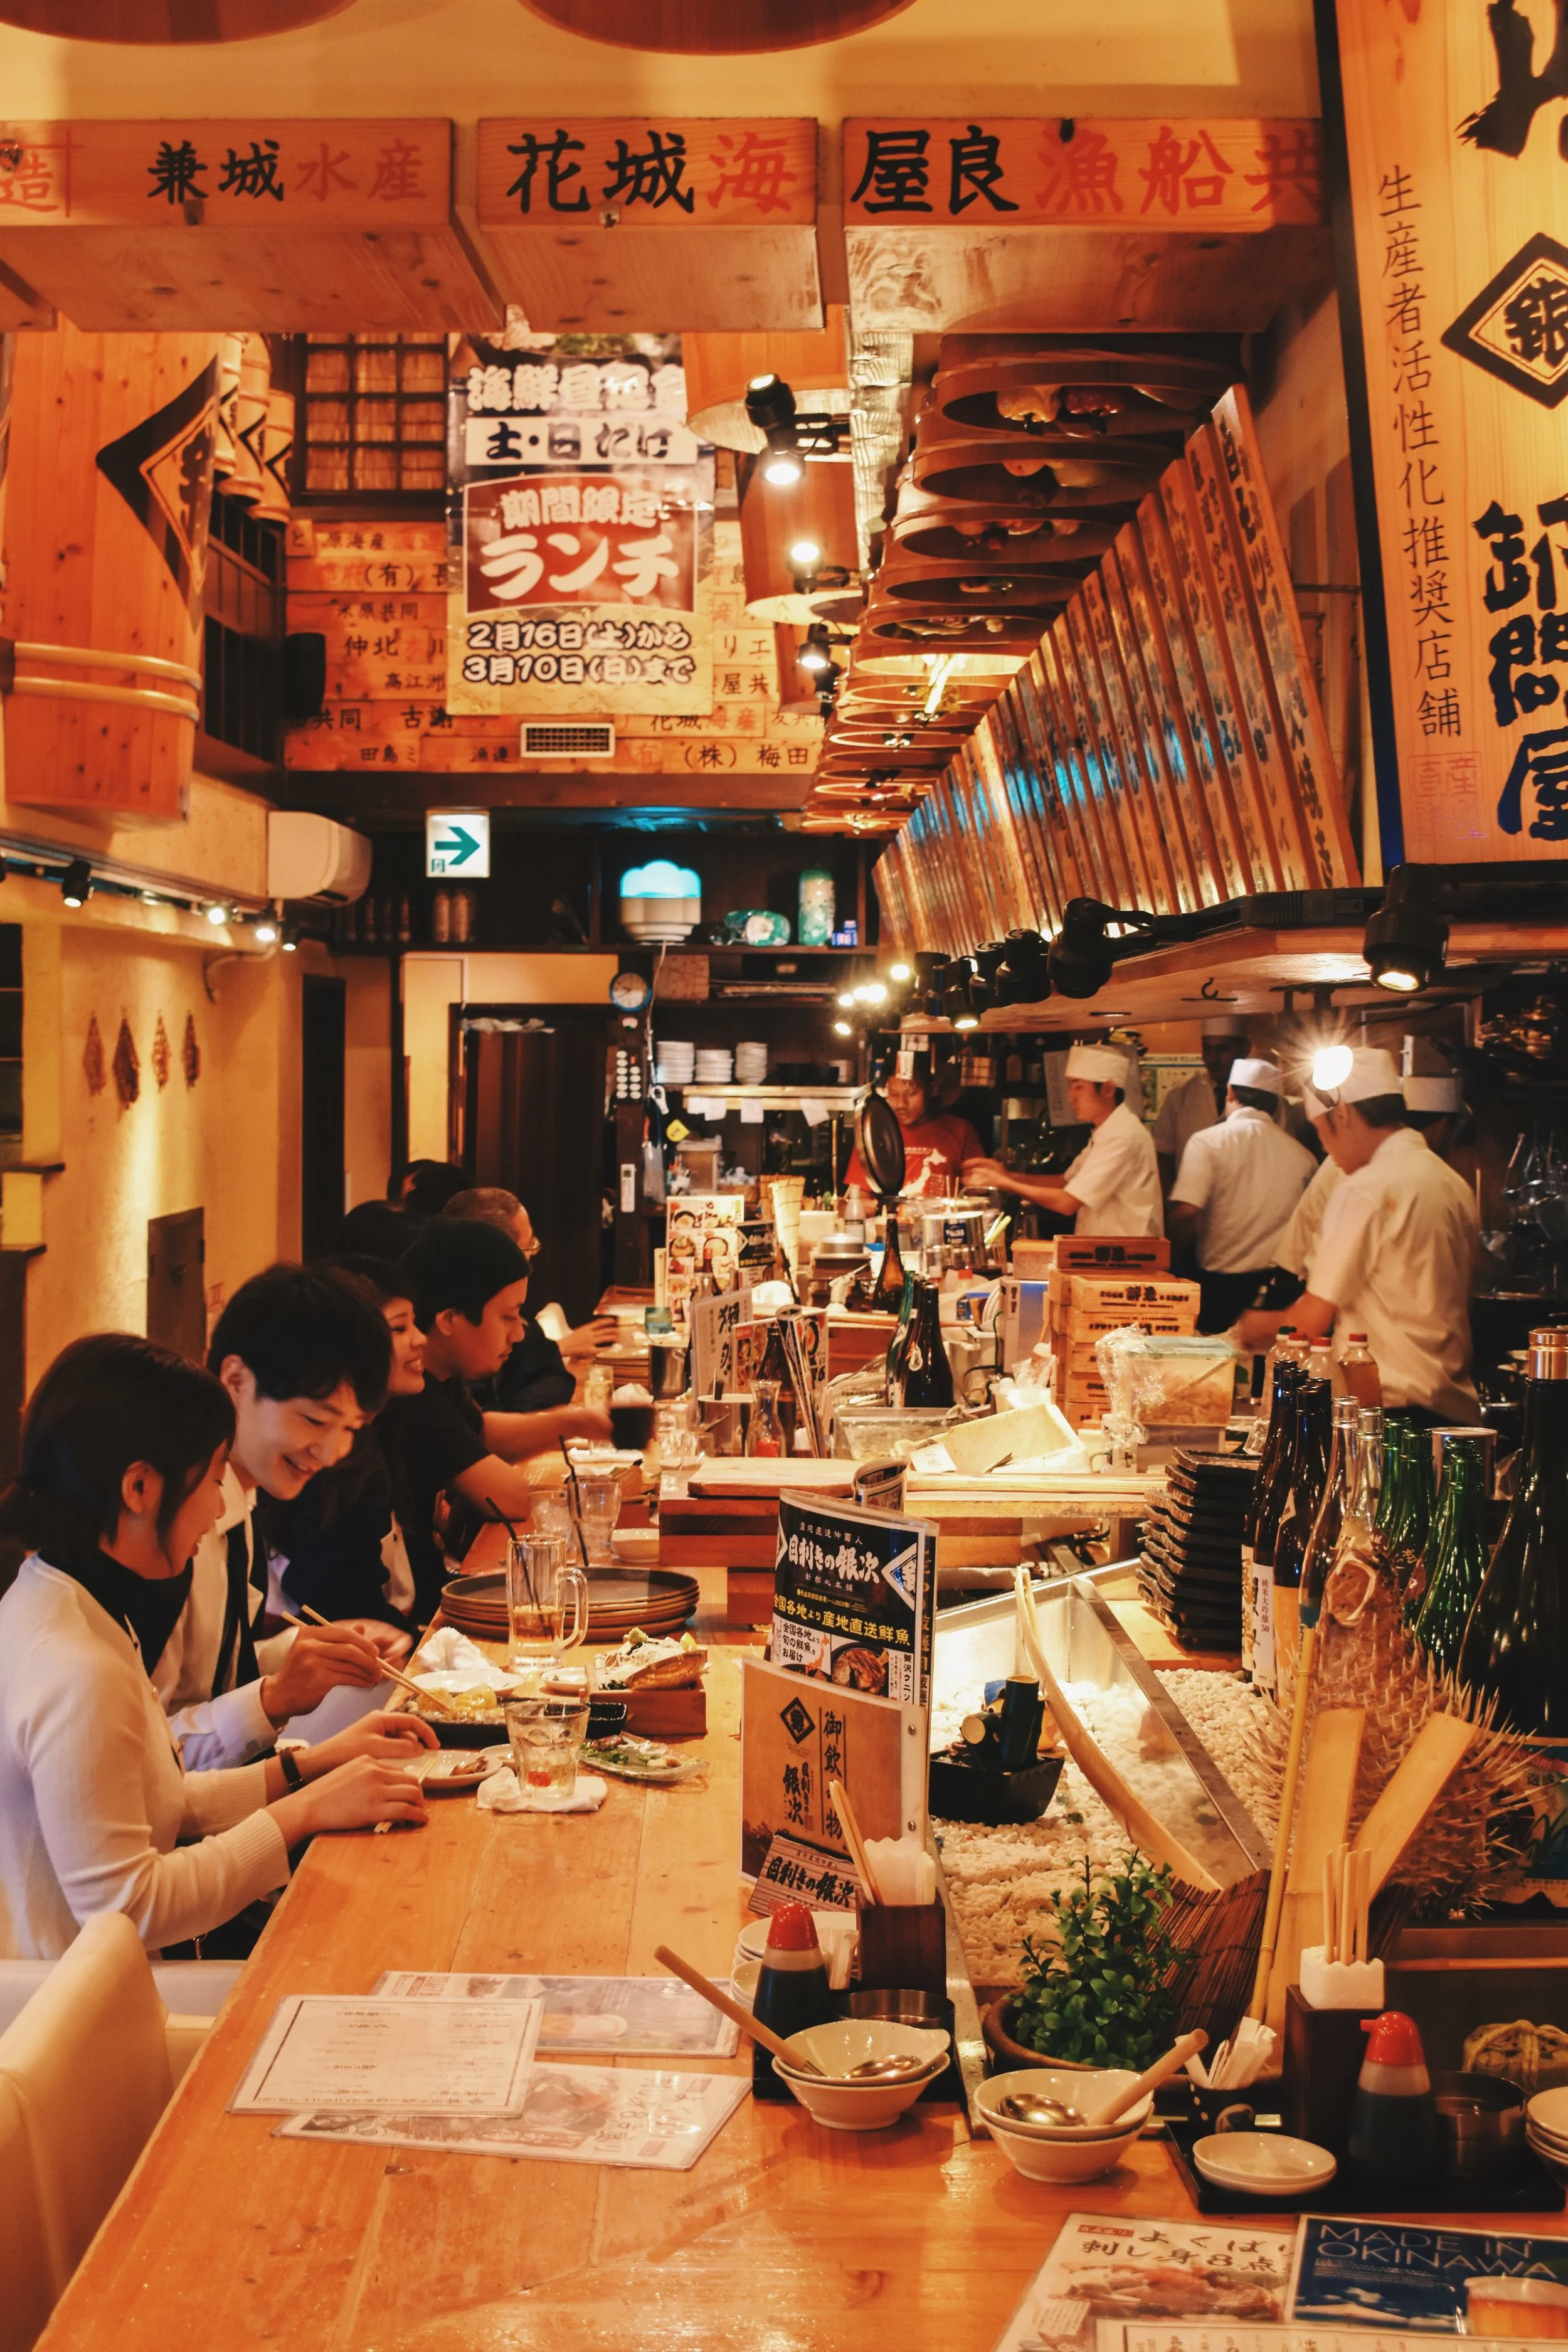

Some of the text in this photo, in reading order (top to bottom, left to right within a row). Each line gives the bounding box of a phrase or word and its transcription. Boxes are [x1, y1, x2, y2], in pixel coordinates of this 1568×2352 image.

[501, 485, 660, 529] 期間限定
[479, 533, 679, 600] ランチ
[467, 620, 692, 653] 2月16日(土)から
[462, 654, 696, 685] 3月10日(日)まで
[788, 1534, 881, 1584] 目利きの銀次
[823, 1710, 843, 1840] 御飲物
[1082, 2239, 1292, 2274] 刺し身8点
[1320, 2223, 1532, 2259] MADE IN
[1317, 2242, 1557, 2279] OKINAWA
